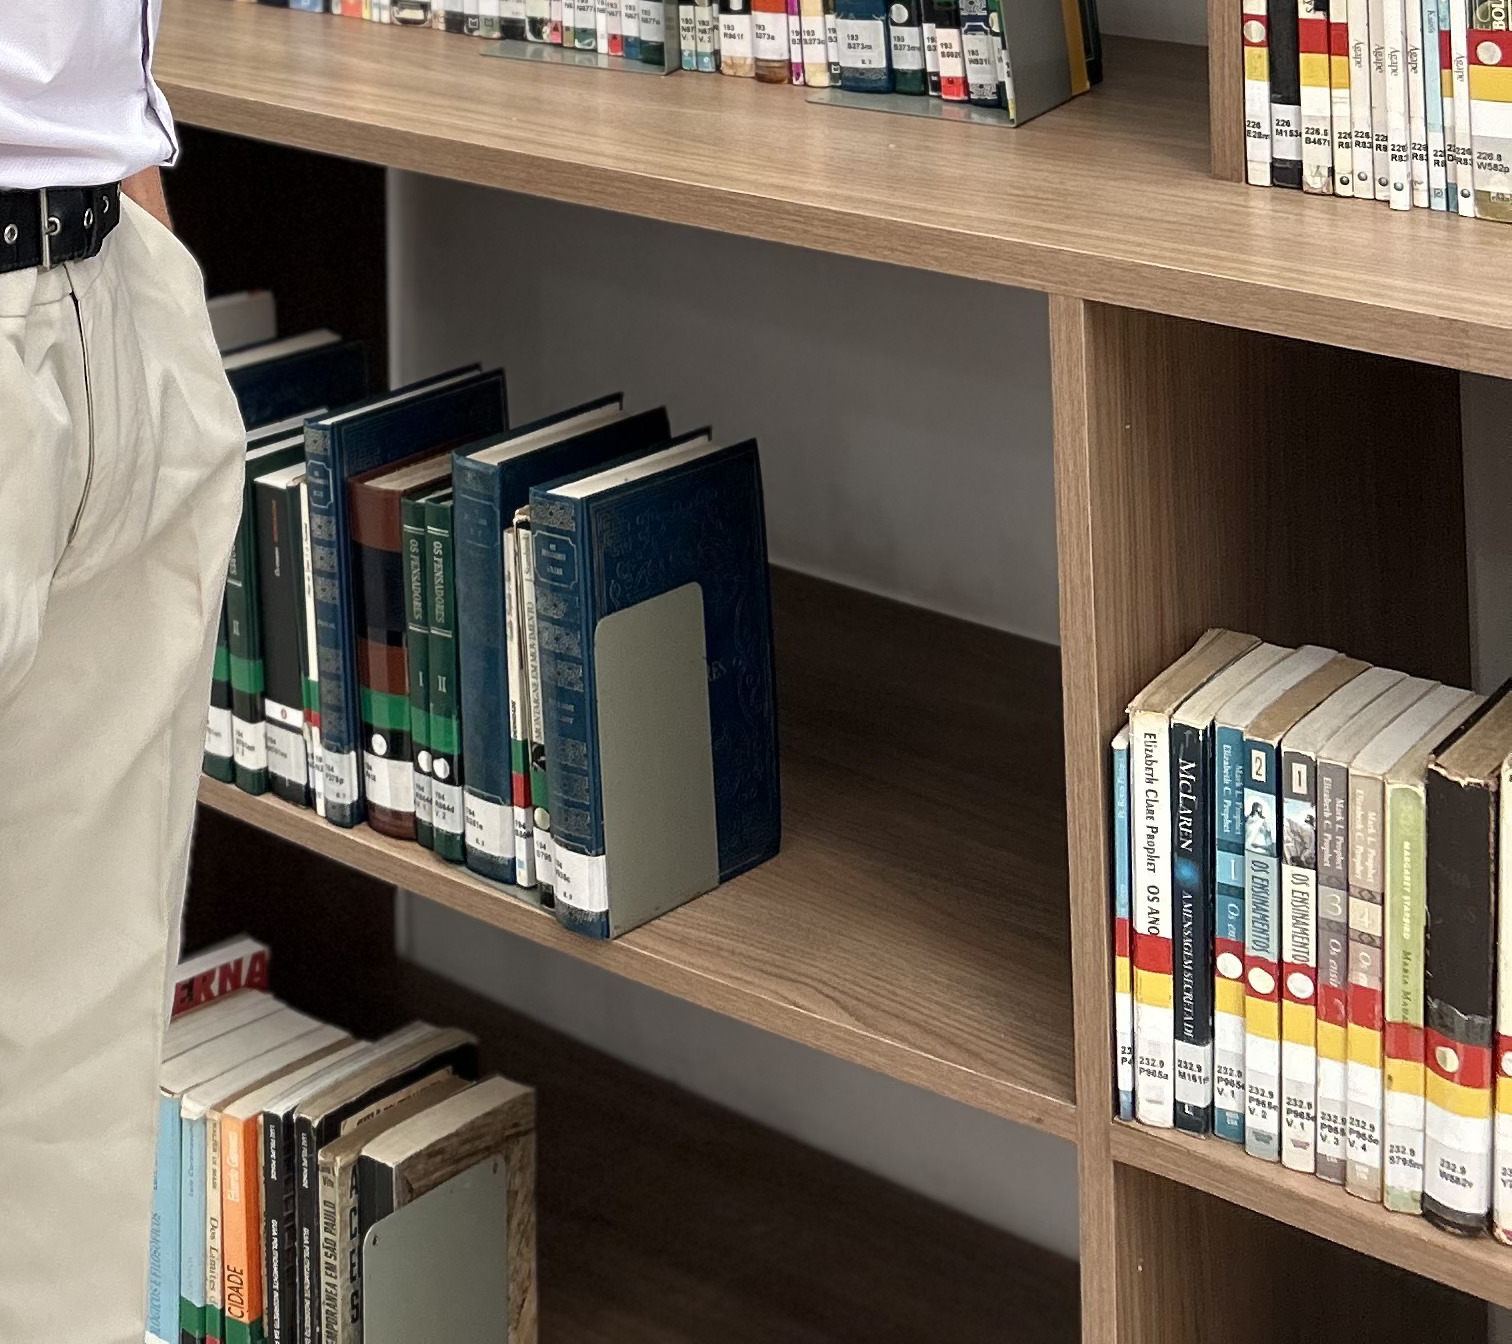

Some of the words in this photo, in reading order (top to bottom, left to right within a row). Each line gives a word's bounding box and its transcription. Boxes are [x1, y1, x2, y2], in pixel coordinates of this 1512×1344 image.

[410, 539, 418, 554] OS
[433, 541, 443, 555] OS
[410, 557, 422, 620] PENSADORES
[433, 558, 445, 623] PENSADORES
[1255, 758, 1263, 776] 2
[1296, 770, 1303, 787] 1
[1252, 860, 1270, 875] OS
[1291, 873, 1310, 887] OS
[1252, 875, 1270, 954] ENSINAMENTOS
[1327, 895, 1341, 916] 3
[1147, 906, 1160, 936] ANO
[1291, 888, 1310, 962] ENSINAMENTO
[323, 1200, 336, 1235] PAULO
[322, 1236, 337, 1262] SÃO
[208, 1245, 219, 1292] Limites
[325, 1263, 337, 1280] EM
[227, 1265, 244, 1319] CIDADE
